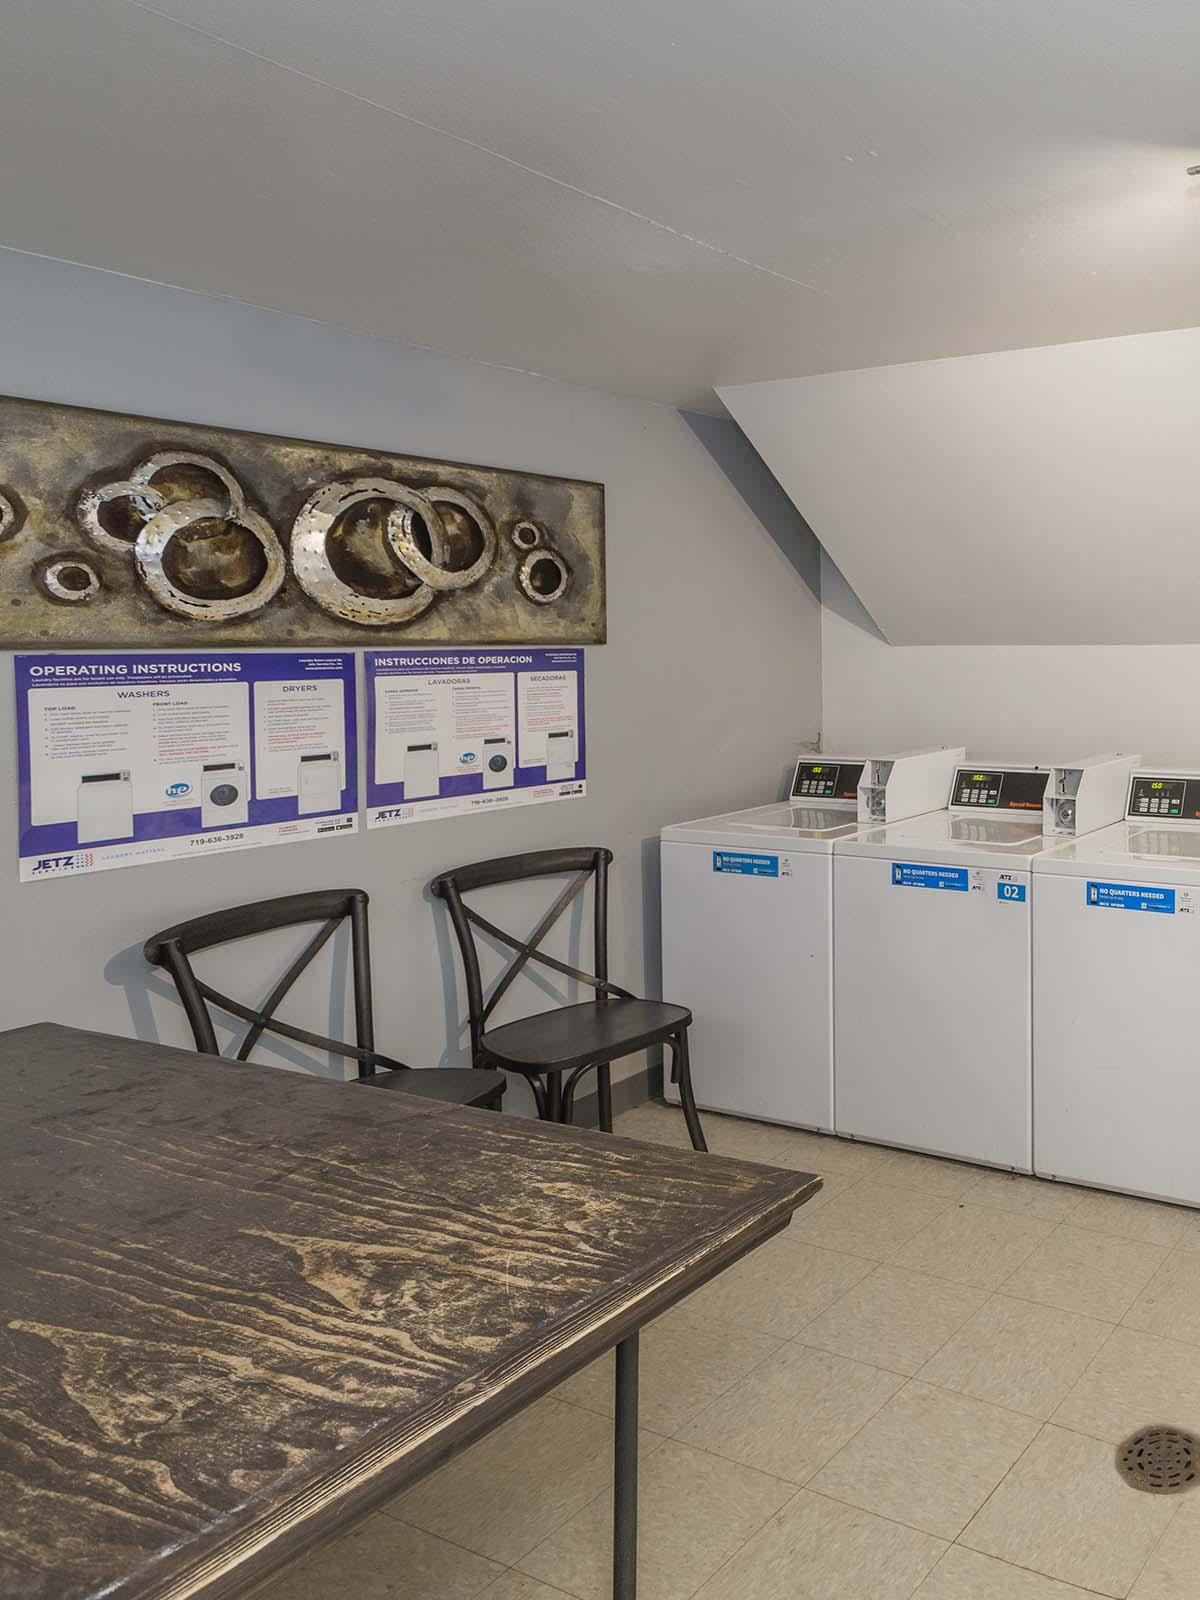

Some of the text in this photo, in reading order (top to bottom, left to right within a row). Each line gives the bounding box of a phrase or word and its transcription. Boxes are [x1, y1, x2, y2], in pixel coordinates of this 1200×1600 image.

[374, 655, 532, 666] INSTRUCCIONES DE OPERACION
[29, 662, 242, 676] OPERATING INSTRUCTIONS
[427, 678, 471, 686] LAVADORAS
[117, 690, 170, 699] WASHERS
[282, 685, 318, 693] DRYERS
[375, 808, 401, 820] JETZ
[32, 855, 75, 871] JETZ
[912, 869, 938, 878] QUARTERS
[938, 871, 959, 879] NEEDED
[1003, 885, 1020, 899] 02
[1099, 887, 1165, 900] NO QUARTERS NEEDED
